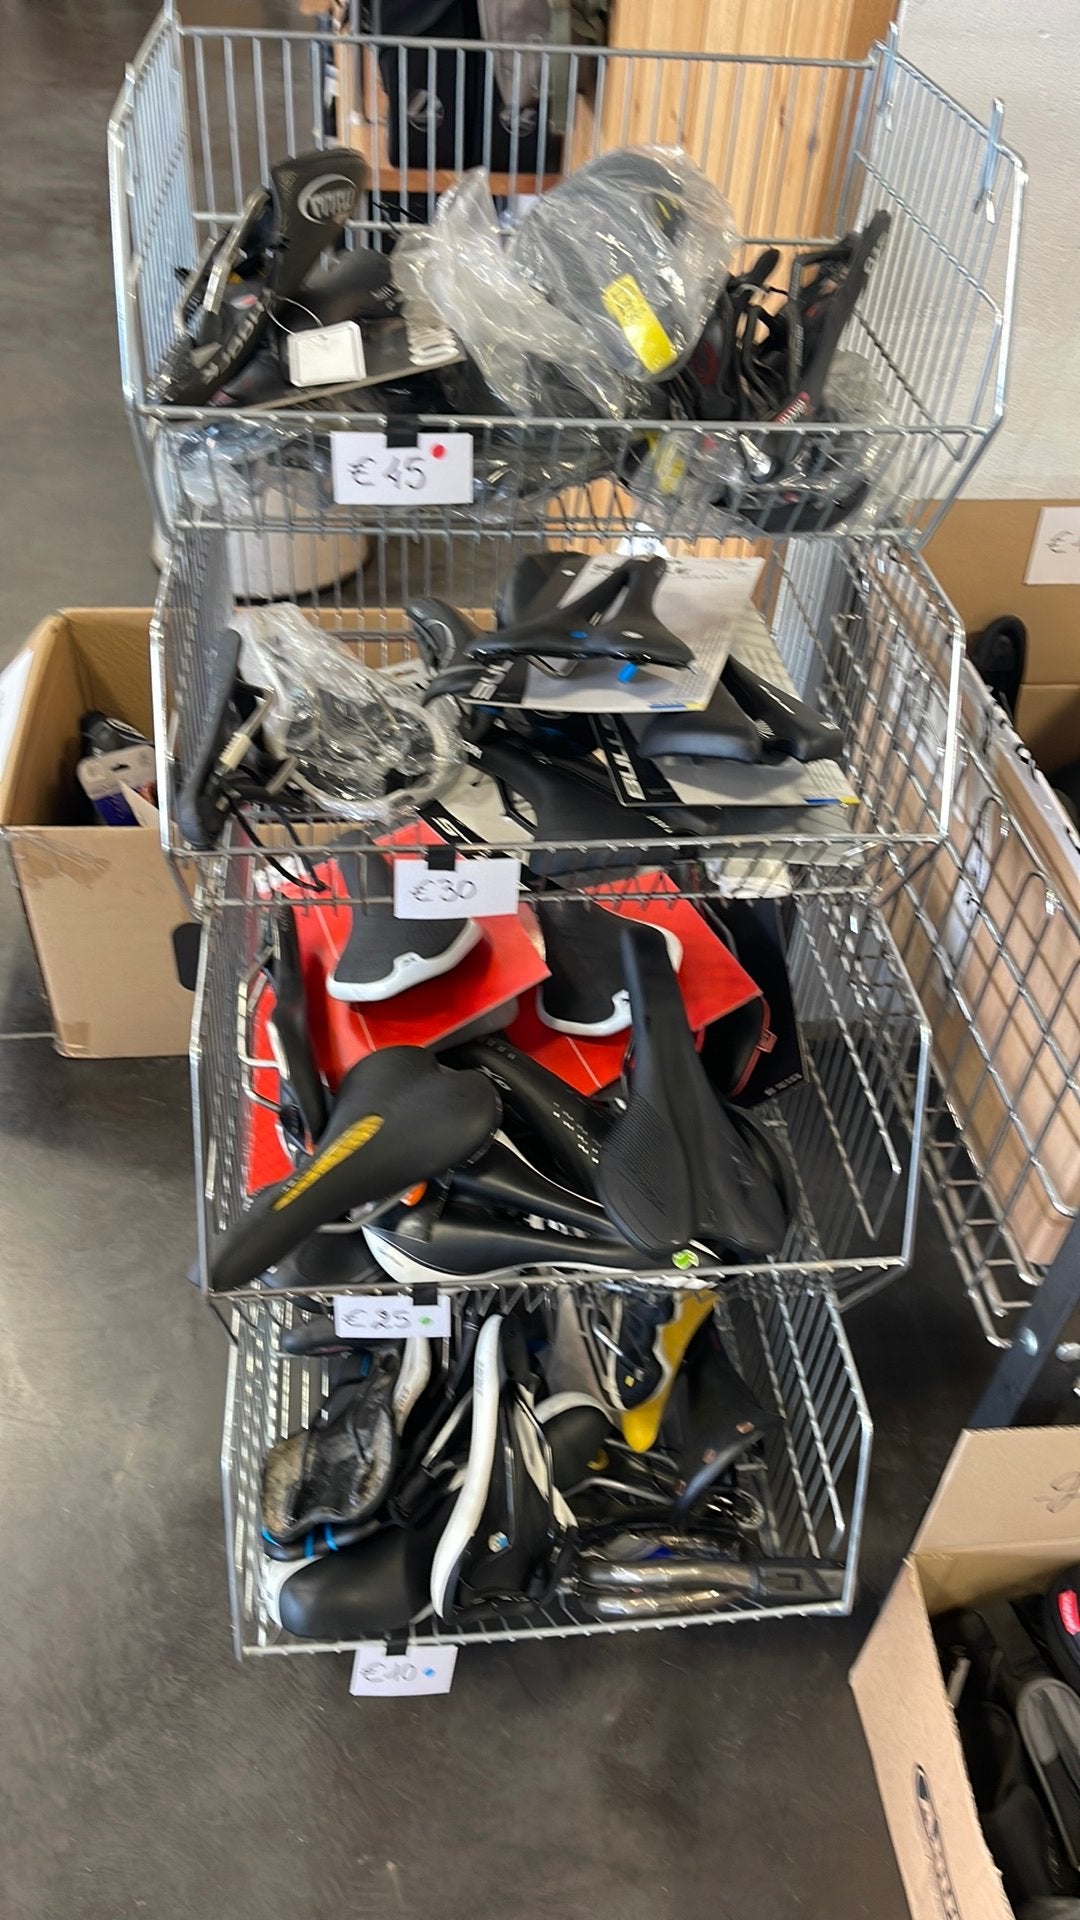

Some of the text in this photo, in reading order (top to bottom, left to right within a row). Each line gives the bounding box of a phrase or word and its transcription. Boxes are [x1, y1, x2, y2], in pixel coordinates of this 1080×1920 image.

[347, 456, 427, 490] €45
[409, 879, 478, 902] €30
[341, 1308, 412, 1330] €25
[360, 1661, 418, 1682] €10
